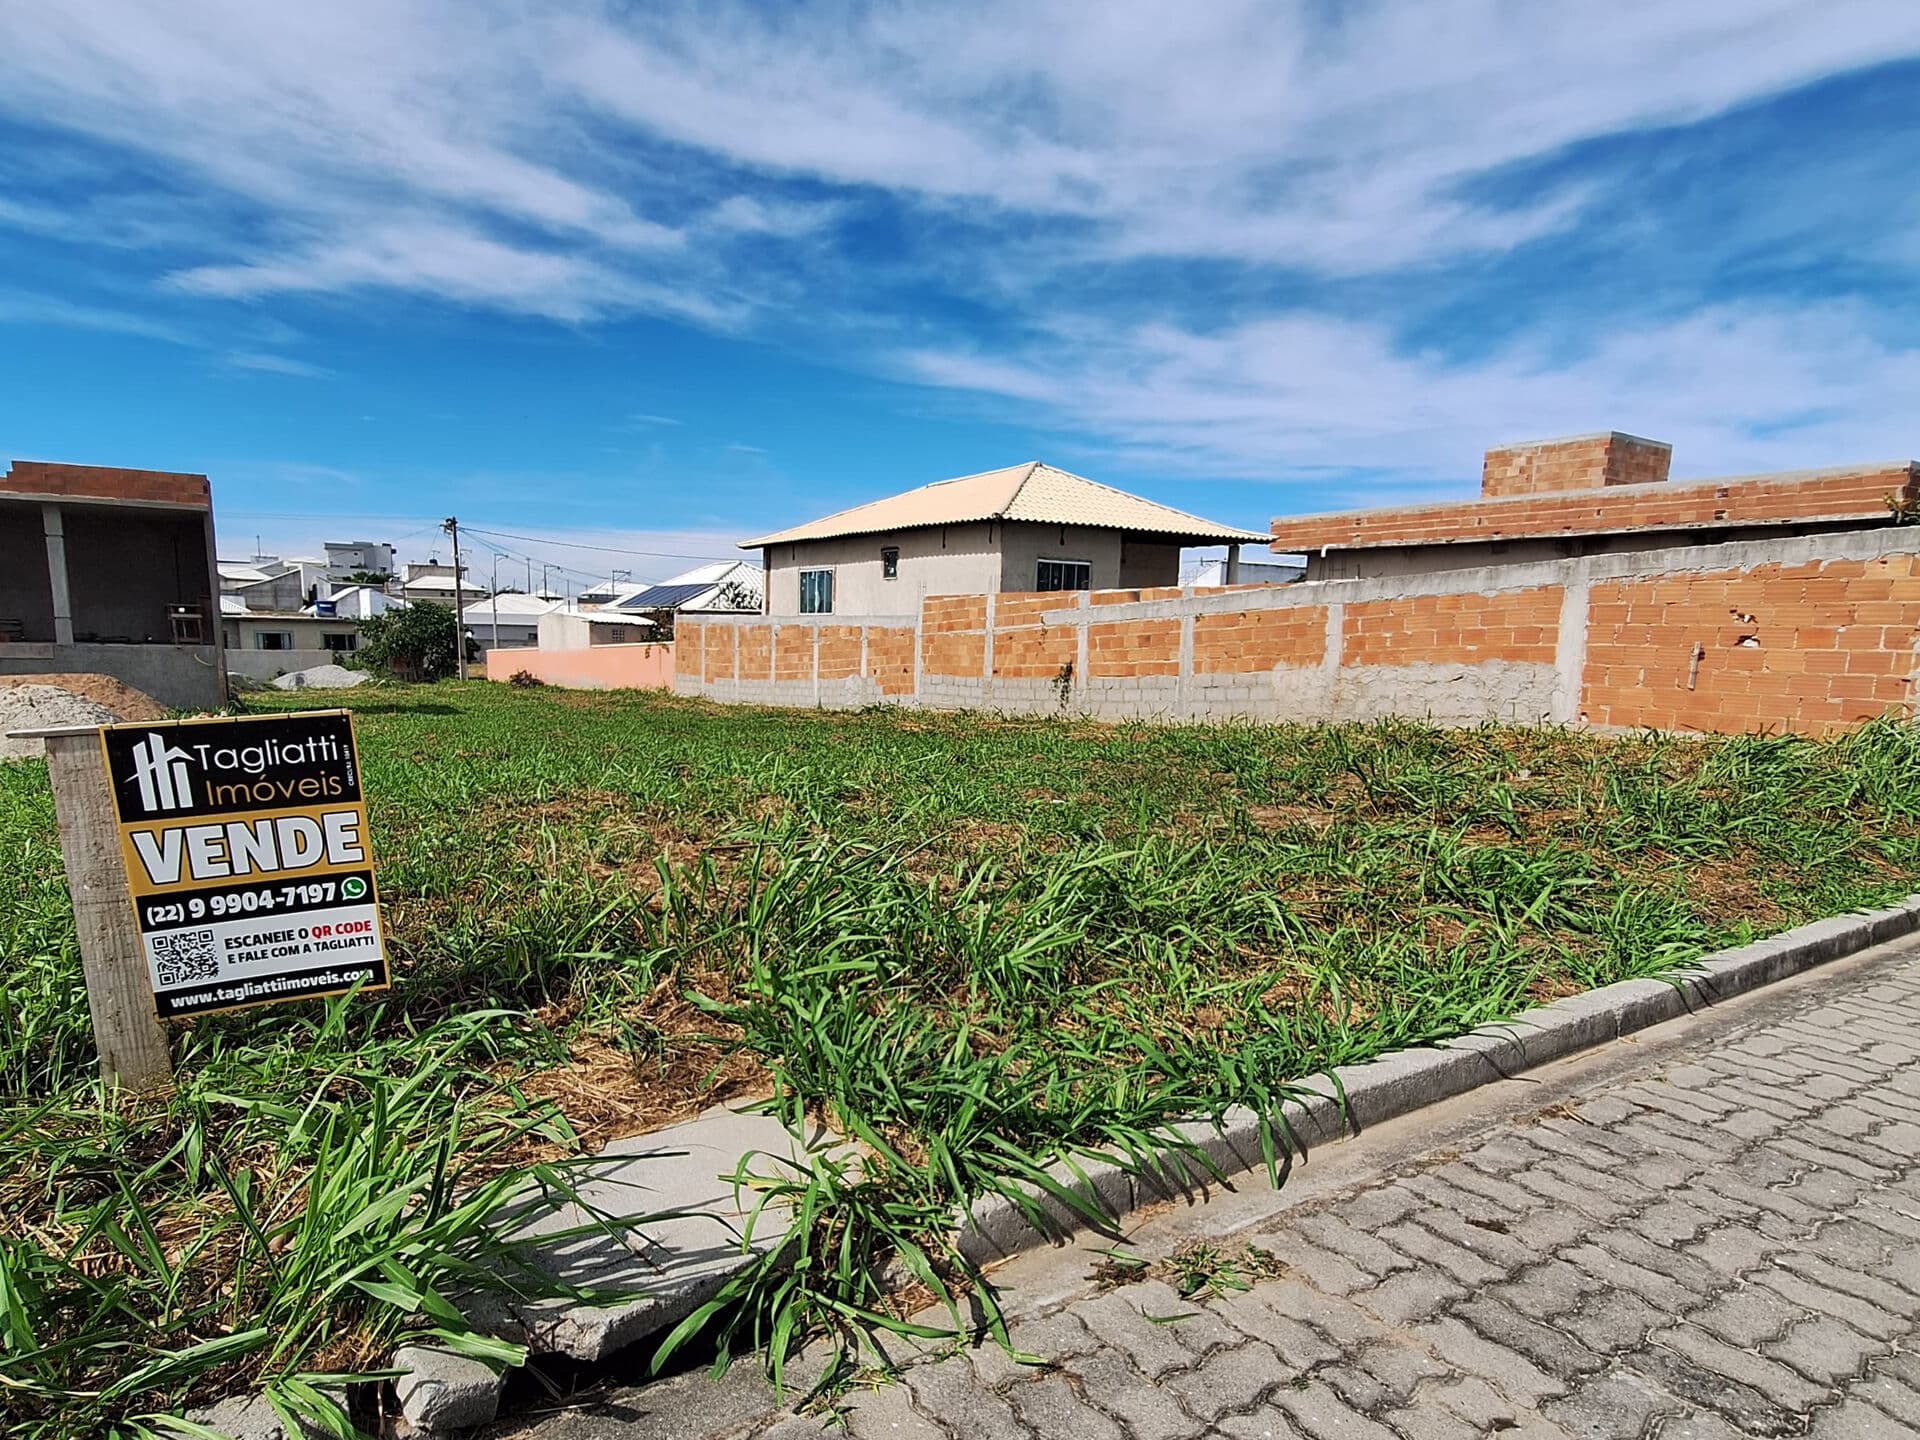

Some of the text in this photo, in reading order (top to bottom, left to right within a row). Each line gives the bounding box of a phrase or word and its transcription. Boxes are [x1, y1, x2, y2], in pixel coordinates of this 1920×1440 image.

[194, 735, 338, 773] Tagliatti
[206, 771, 342, 805] Imóveis
[131, 811, 364, 885] VENDE
[147, 882, 336, 926] (22) 9 9904-7197
[224, 920, 373, 950] ESCANEIE O QR CODE
[227, 935, 375, 964] E FALE COM A TAGLIATTI
